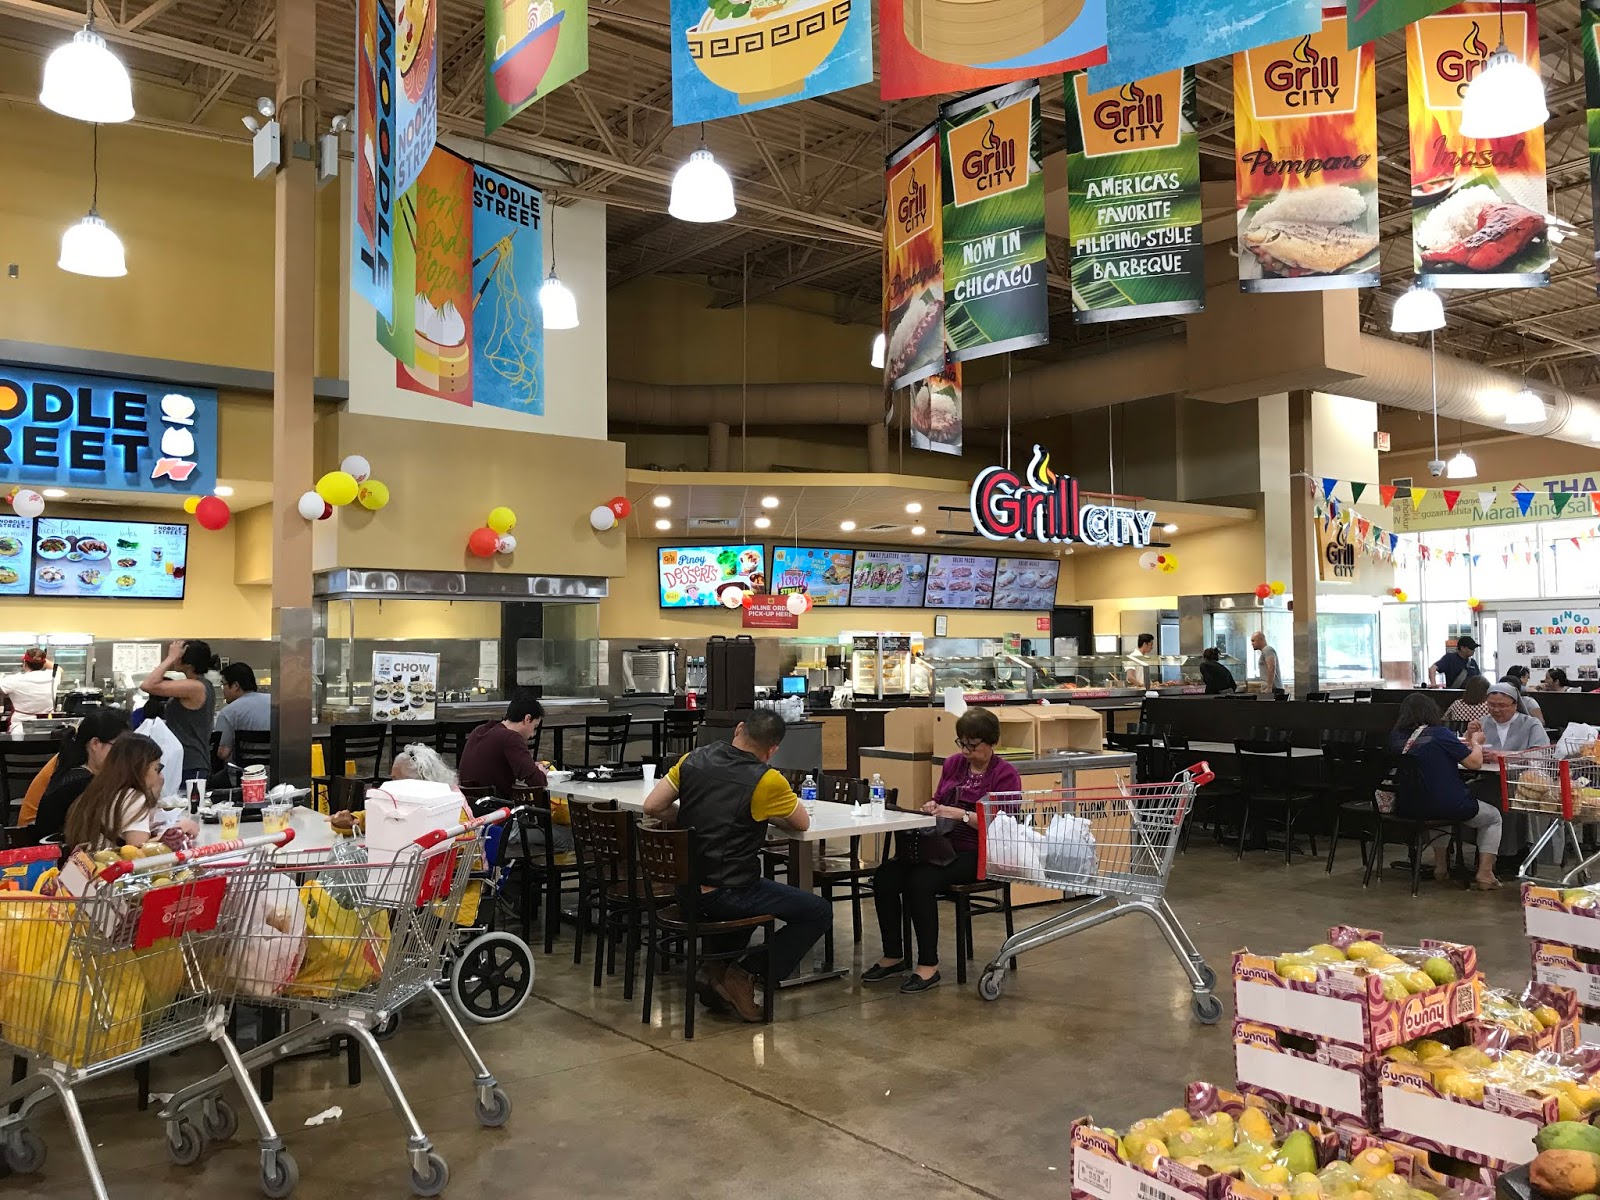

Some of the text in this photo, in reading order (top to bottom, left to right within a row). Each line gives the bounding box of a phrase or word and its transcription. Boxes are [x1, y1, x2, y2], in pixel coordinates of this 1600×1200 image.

[1264, 56, 1339, 91] Grill
[1437, 50, 1495, 82] Gri
[1285, 88, 1339, 107] CITY
[399, 74, 436, 159] NOODLE
[1093, 93, 1163, 130] Grill
[1113, 123, 1164, 144] CITY
[398, 109, 436, 189] STREET
[962, 138, 1015, 179] Grill
[1432, 135, 1525, 168] Inasal
[1242, 147, 1371, 180] Pompano
[473, 169, 540, 214] NOODLE
[976, 167, 1016, 191] CITY
[1086, 173, 1180, 199] AMERICA'S
[473, 191, 541, 230] STREET
[897, 183, 927, 223] Grill
[1097, 201, 1171, 226] FAVORITE
[905, 209, 927, 233] CITY
[963, 230, 1021, 266] NOW IN
[1076, 227, 1192, 256] FILIPINO-STYLE
[1093, 254, 1182, 280] BARBEQUE
[954, 263, 1032, 300] CHICAGO
[971, 467, 1079, 541] Grill
[1080, 505, 1156, 547] CITY
[678, 555, 706, 566] Pinoy
[1326, 542, 1354, 566] Grill
[1333, 564, 1354, 577] CITY
[1552, 611, 1590, 625] BINGO
[393, 663, 430, 672] CHOW
[1079, 799, 1129, 820] THANK YOU
[1525, 893, 1553, 908] bunny
[1236, 962, 1268, 981] bunny
[1536, 951, 1567, 966] bunny
[1405, 1003, 1445, 1030] bunny
[1237, 1024, 1269, 1045] bunny
[1382, 1064, 1421, 1089] bunny
[1075, 1127, 1107, 1153] bunny
